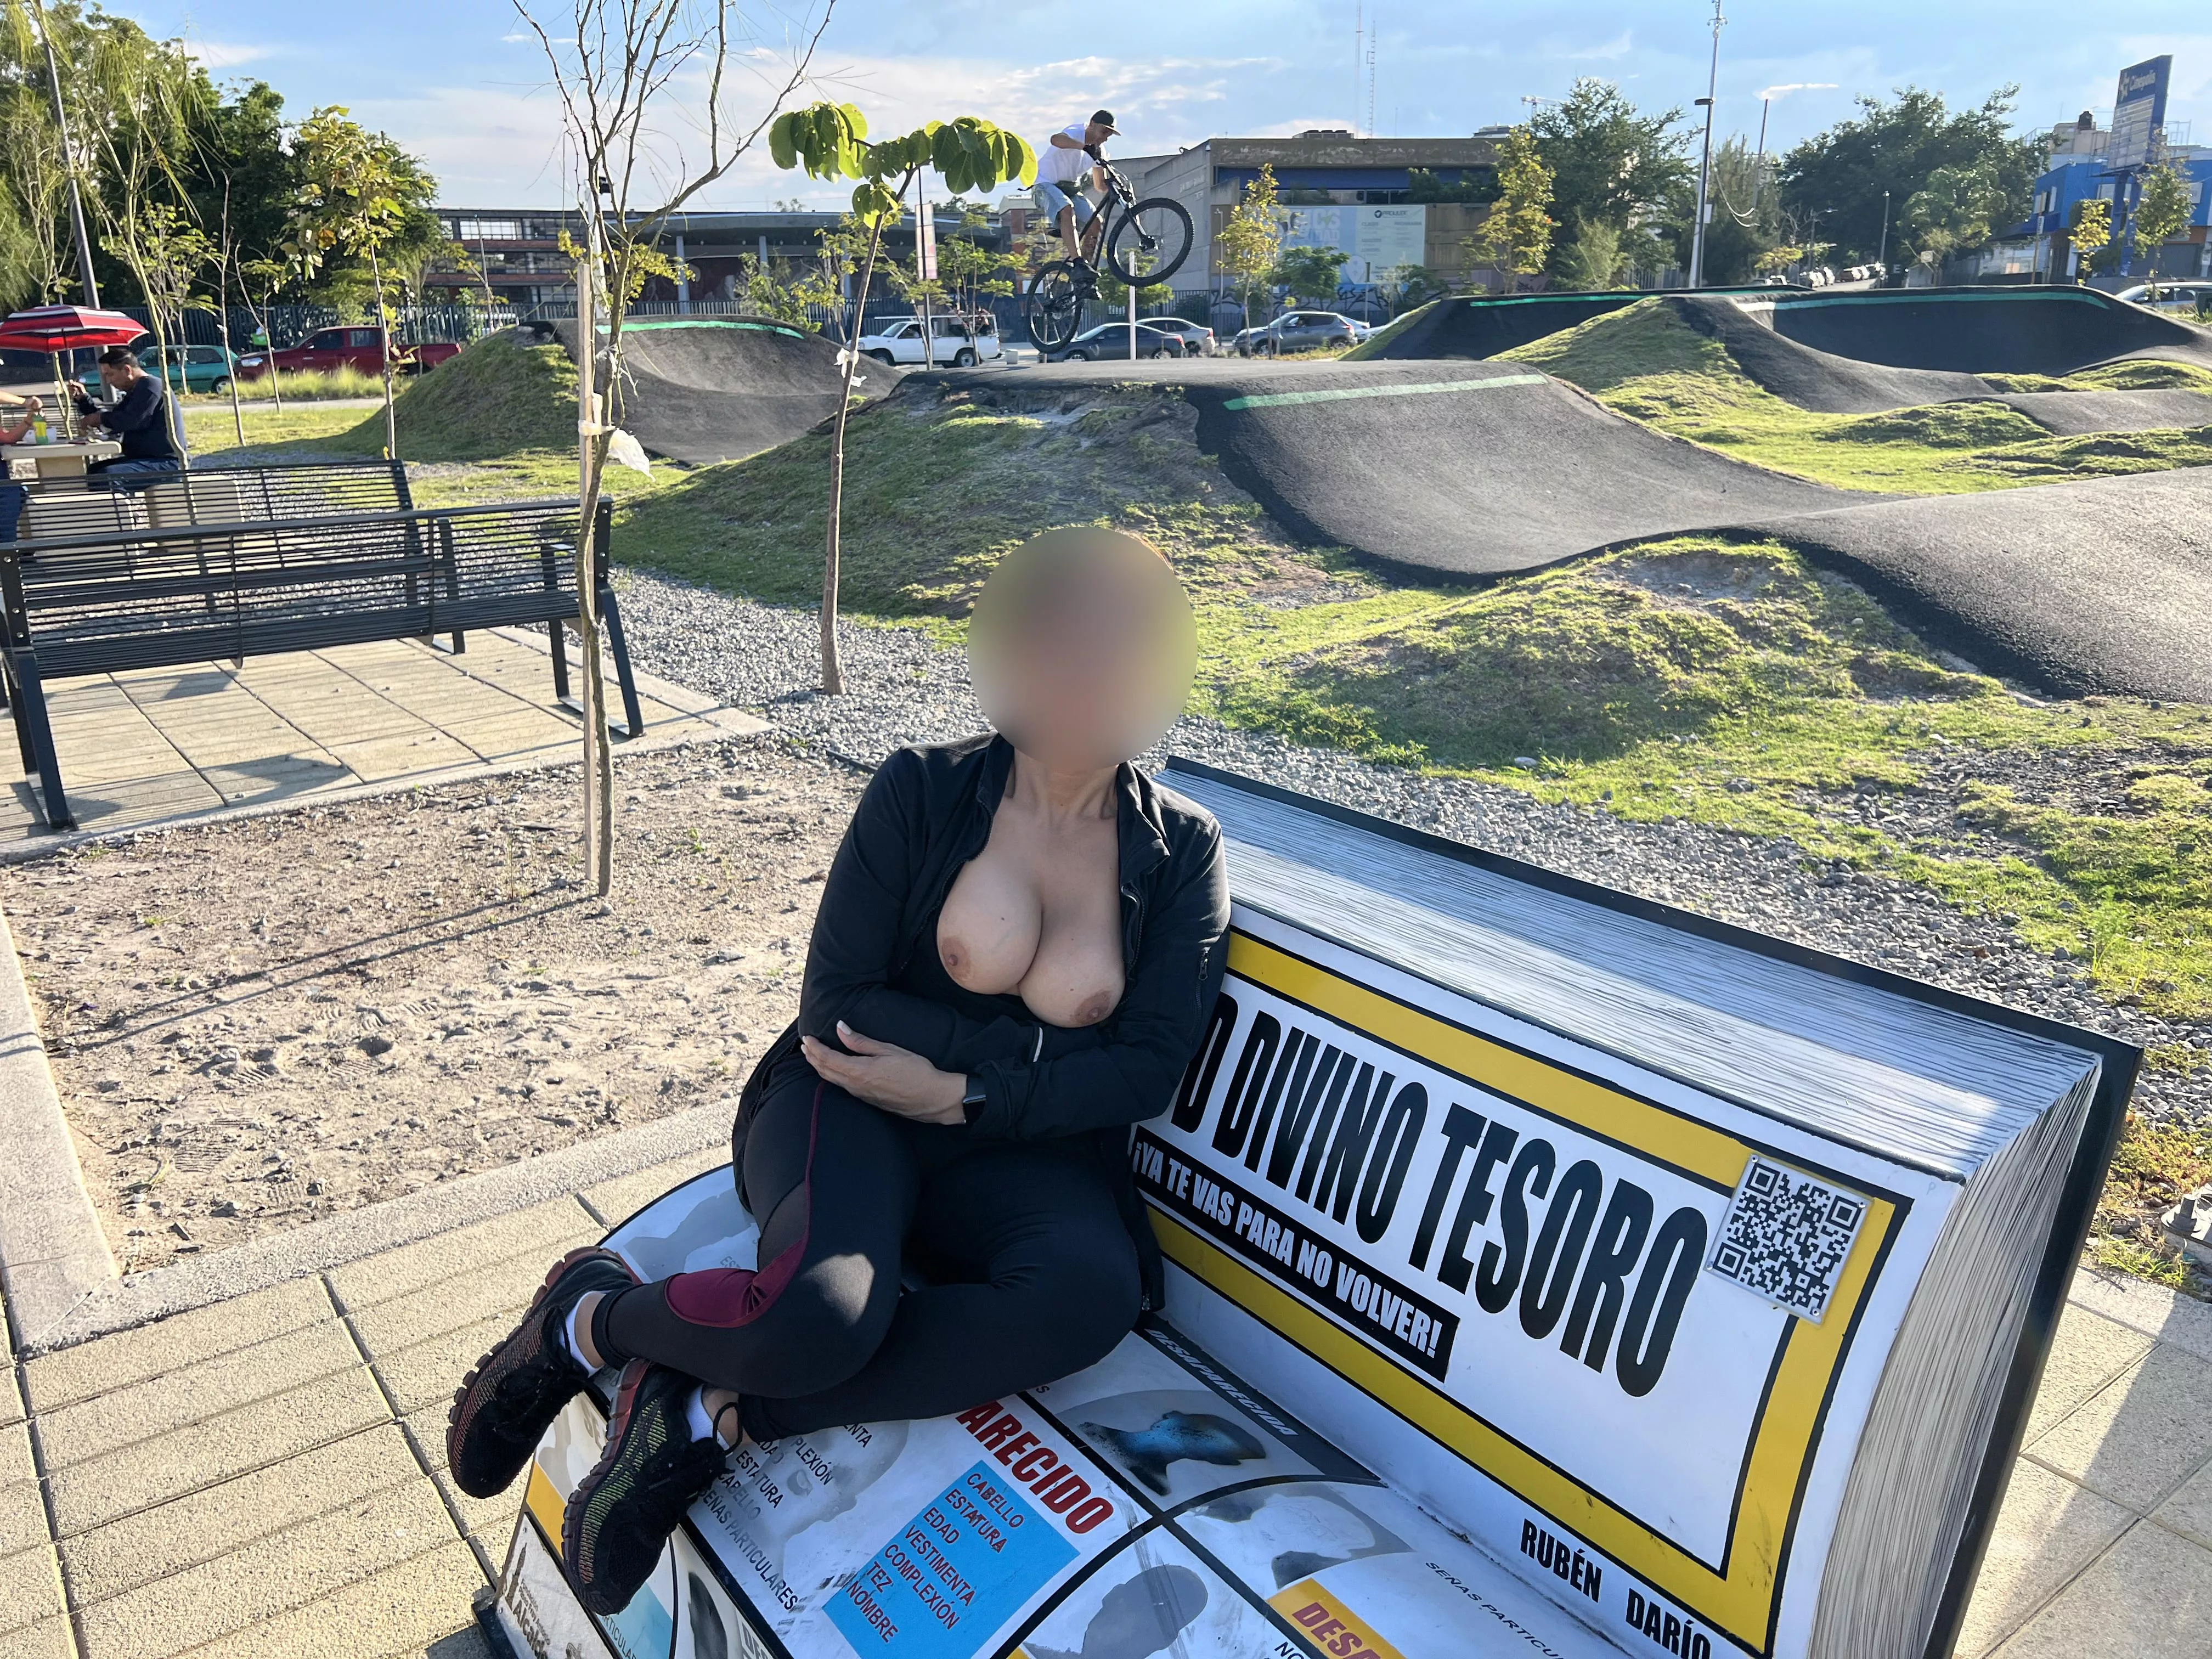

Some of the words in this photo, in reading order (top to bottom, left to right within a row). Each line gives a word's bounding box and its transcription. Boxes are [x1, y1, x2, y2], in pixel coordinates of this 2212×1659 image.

[1211, 1010, 1428, 1244] DIVINO
[1408, 1102, 1707, 1397] TESORO
[1166, 1158, 1191, 1200] TE
[1192, 1174, 1234, 1226] VAS
[1234, 1201, 1295, 1267] PARA
[1296, 1238, 1333, 1288] NO
[1335, 1262, 1443, 1359] VOLVER!
[1144, 1329, 1299, 1436] DESAPARECIDA
[735, 1450, 784, 1509] ESTATURA
[945, 1488, 1008, 1554] ESTATURA
[967, 1472, 1025, 1528] CABELLO
[725, 1521, 798, 1610] PARTICULARES
[905, 1525, 977, 1607] VESTIMENTA
[923, 1507, 960, 1544] EDAD
[845, 1580, 899, 1644] NOMBRE
[866, 1561, 893, 1594] TEZ
[884, 1544, 960, 1630] COMPLEXIÓN
[1426, 1562, 1482, 1601] SEÑAS
[1480, 1604, 1564, 1659] PARTICU
[1520, 1518, 1602, 1603] RUBÉN
[1625, 1588, 1711, 1659] DARÍO
